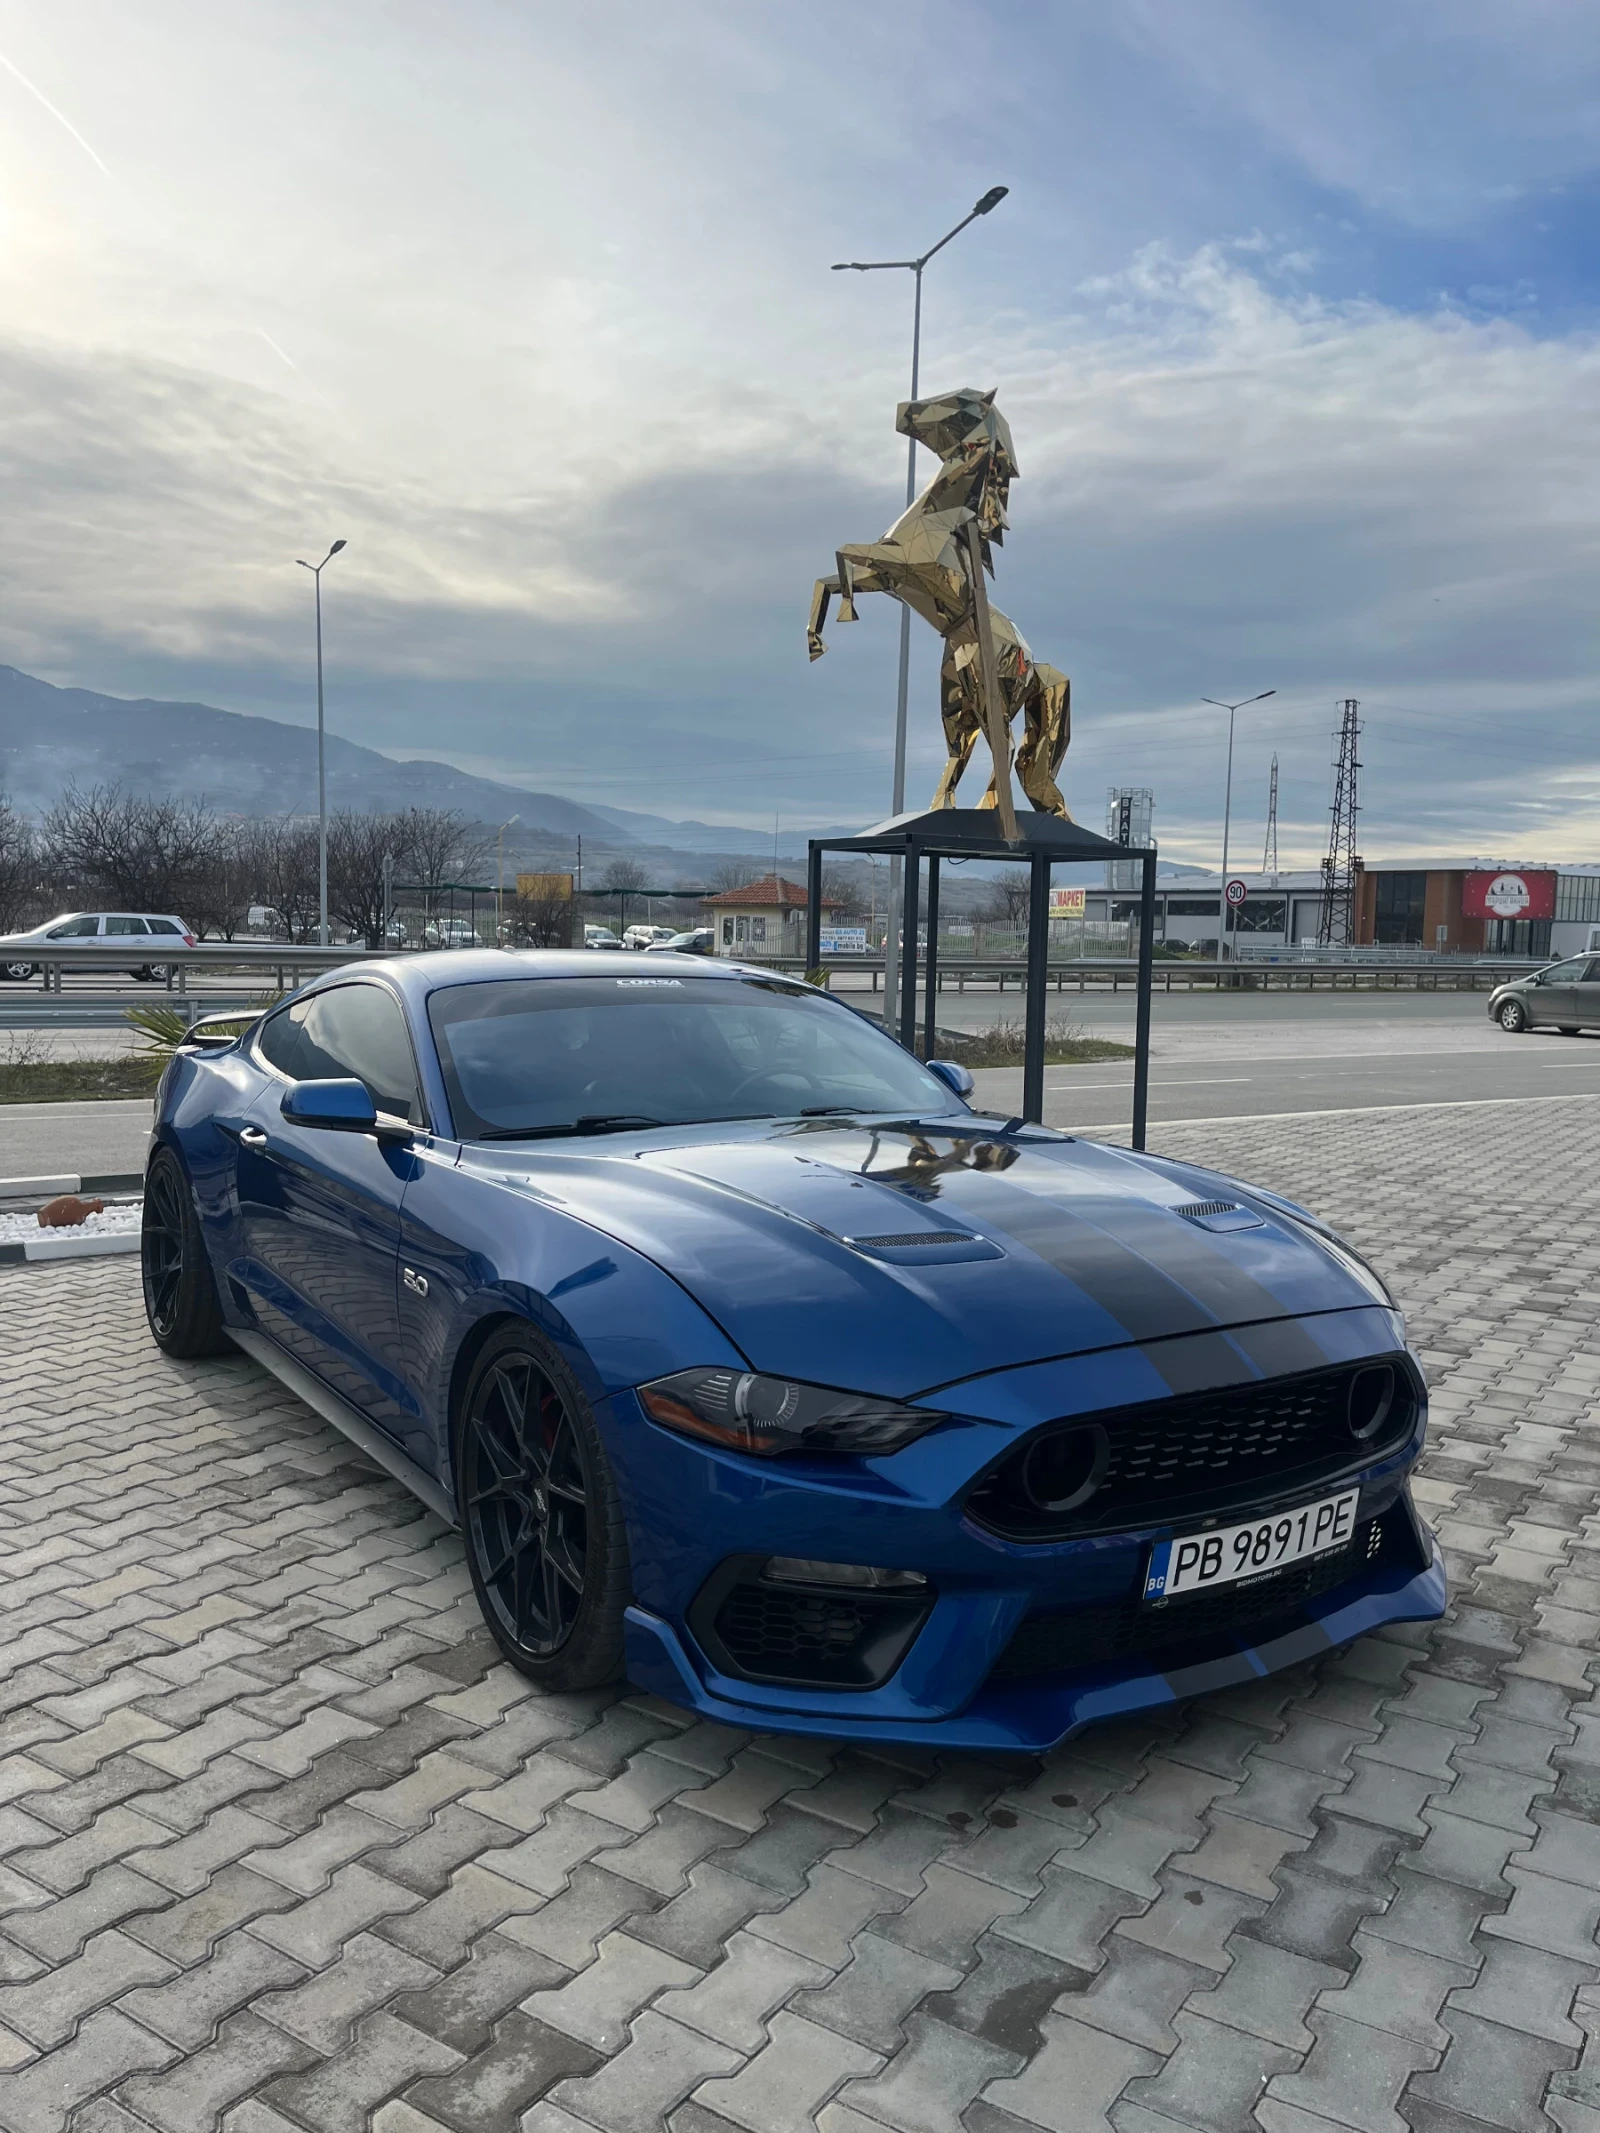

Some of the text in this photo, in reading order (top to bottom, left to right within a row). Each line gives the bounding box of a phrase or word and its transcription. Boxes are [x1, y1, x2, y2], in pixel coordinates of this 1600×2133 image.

[1057, 890, 1084, 907] МАРКЕТ
[1229, 886, 1242, 899] 90
[1172, 1496, 1353, 1587] PB 9891 PE
[1147, 1576, 1165, 1592] BG
